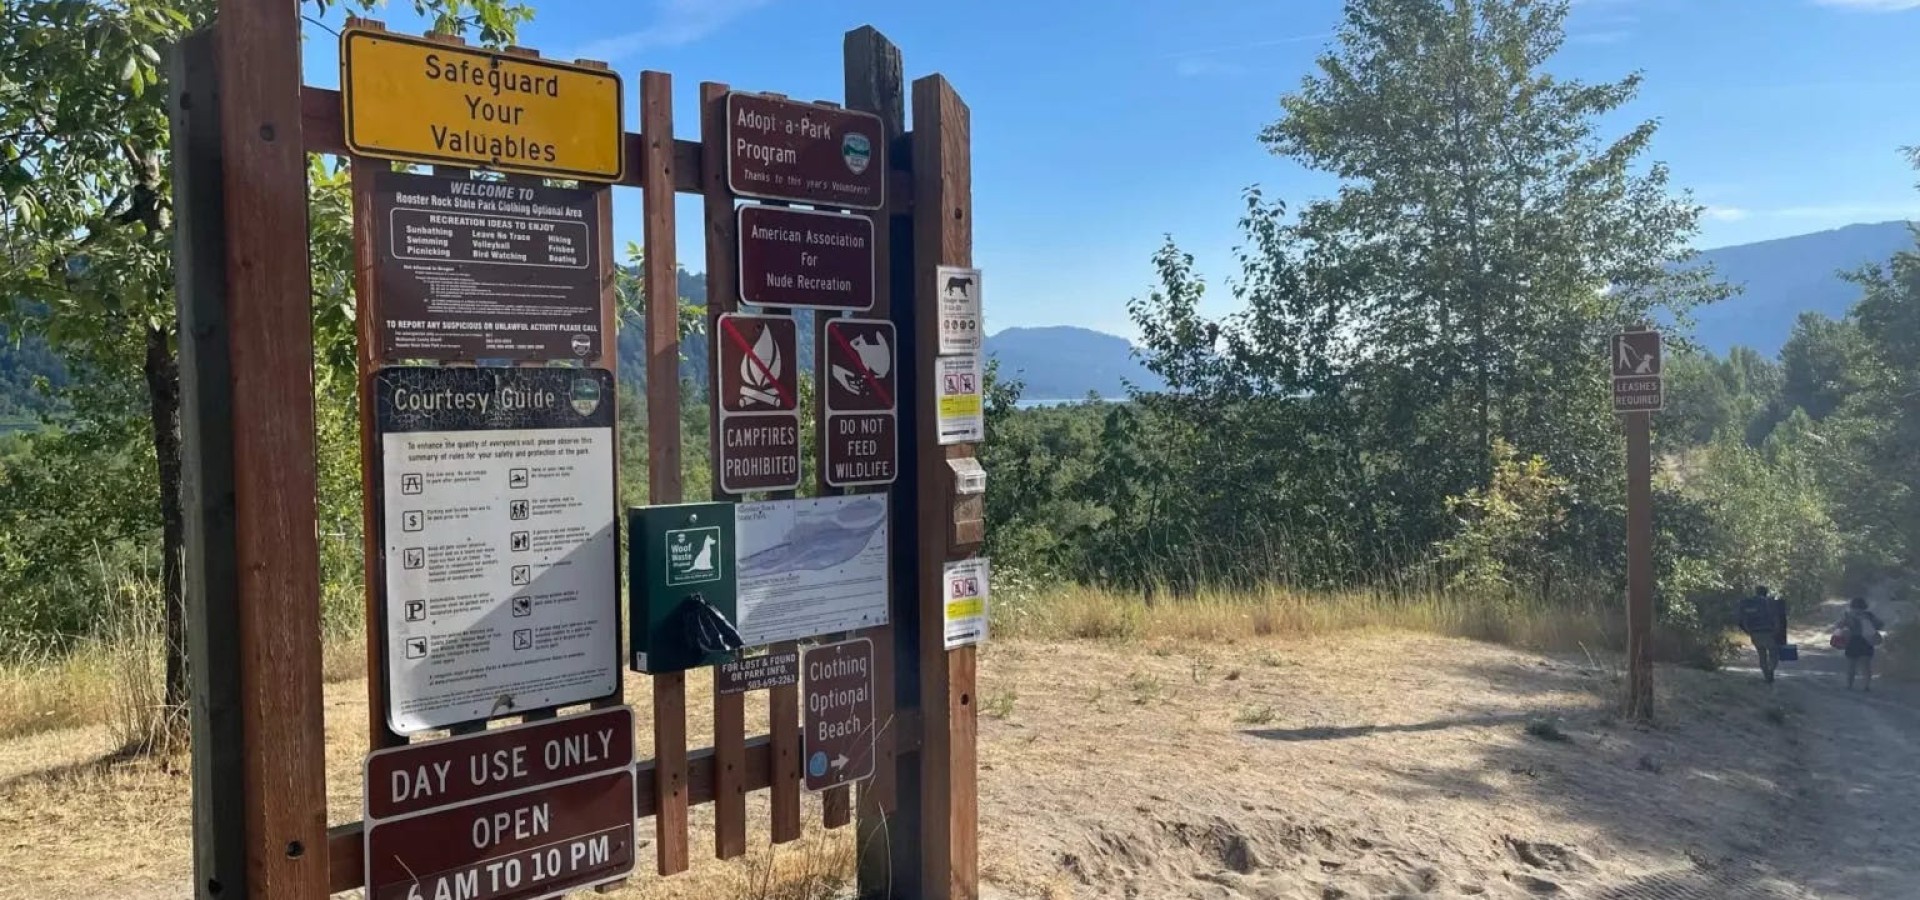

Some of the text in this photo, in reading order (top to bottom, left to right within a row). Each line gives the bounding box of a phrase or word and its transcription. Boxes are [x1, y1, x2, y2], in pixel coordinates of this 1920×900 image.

[426, 54, 558, 98] Safeguard
[465, 95, 524, 126] Your
[431, 125, 556, 162] Valuables
[736, 138, 796, 166] Program
[744, 169, 770, 182] Thanks
[775, 174, 783, 184] to
[788, 176, 800, 186] this
[450, 181, 534, 200] WELCOME TO
[396, 192, 582, 218] Rooster Rock State Park Clothing Optional Area
[406, 225, 453, 238] Sunbathing
[430, 214, 555, 232] RECREATION IDEAS TO ENJOY
[406, 235, 448, 247] Swimming
[472, 230, 530, 241] Leave No Trace
[548, 235, 572, 246] Hiking
[751, 224, 865, 248] American Association
[407, 246, 450, 258] Picnicking
[472, 240, 510, 250] Volleyball
[473, 250, 526, 262] Bird Watching
[549, 254, 576, 264] Boating
[801, 252, 818, 267] For
[766, 272, 851, 291] Nude Recreation
[386, 320, 396, 328] TO
[398, 320, 426, 328] REPORT
[427, 320, 440, 329] ANY
[442, 321, 482, 330] SUSPICIOUS
[484, 322, 492, 330] OR
[494, 322, 529, 330] UNLAWFUL
[1617, 381, 1657, 392] LEASHES
[394, 387, 556, 414] Courtesy Guide
[840, 418, 884, 434] DO NOT
[726, 427, 795, 448] CAMPFIRES
[848, 440, 877, 456] FEED
[726, 456, 796, 478] PROHIBITED
[836, 461, 889, 478] WILDLIFE
[671, 542, 692, 553] Woof
[406, 603, 422, 620] P
[722, 654, 796, 673] FOR LOST & FOUND
[810, 656, 867, 681] Clothing
[731, 672, 742, 682] OR
[744, 668, 766, 680] PARK
[810, 682, 868, 716] Optional
[820, 714, 861, 741] Beach
[392, 728, 614, 803] DAY USE ONLY
[472, 802, 549, 849] OPEN
[434, 868, 478, 900] AM
[486, 858, 521, 892] TO
[531, 848, 562, 882] 10
[570, 834, 610, 872] PM
